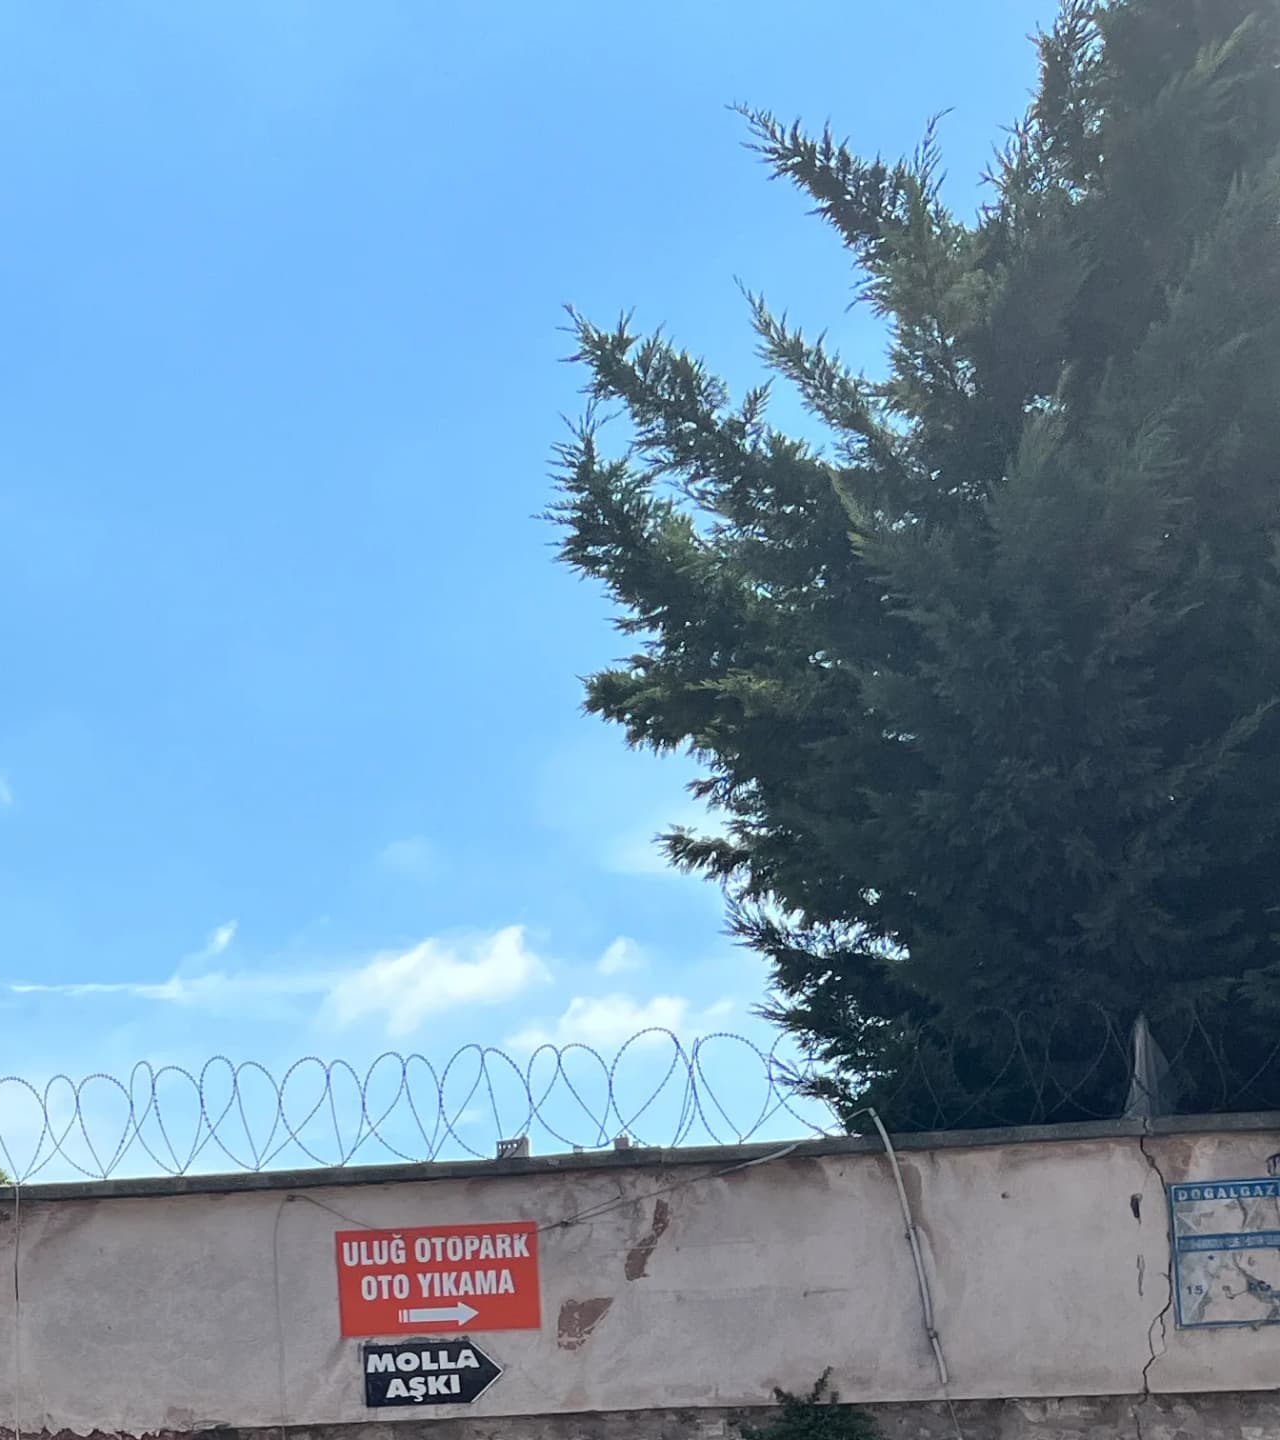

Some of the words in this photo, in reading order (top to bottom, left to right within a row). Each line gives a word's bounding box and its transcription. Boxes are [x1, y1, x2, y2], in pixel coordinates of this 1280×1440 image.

[343, 1233, 407, 1266] ULUĞ
[414, 1232, 530, 1263] OTOPARK
[361, 1273, 410, 1301] OTO
[417, 1268, 515, 1298] YIKAMA
[366, 1348, 480, 1374] MOLLA
[386, 1374, 461, 1402] AŞKI
